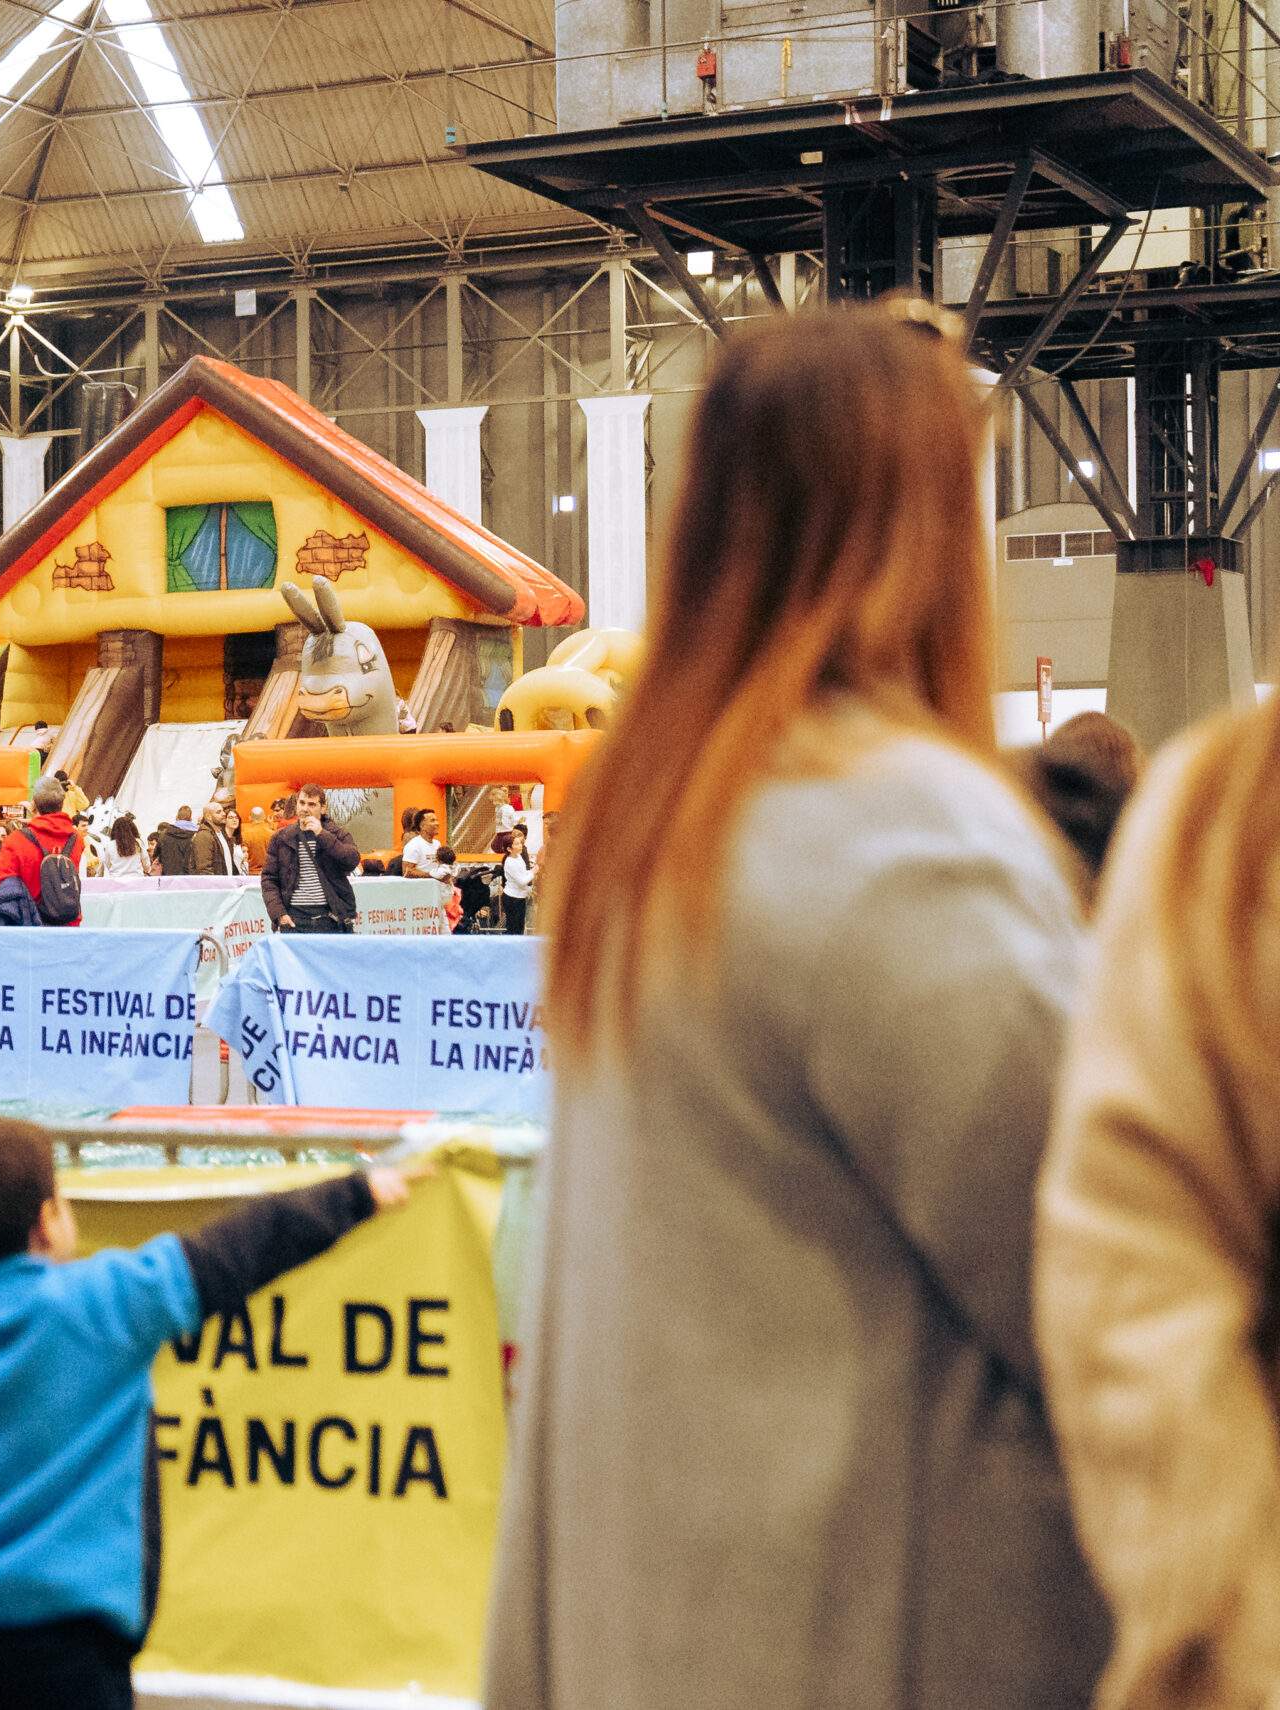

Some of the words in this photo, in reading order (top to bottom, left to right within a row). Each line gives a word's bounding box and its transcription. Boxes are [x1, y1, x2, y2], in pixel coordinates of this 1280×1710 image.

[41, 988, 155, 1019] FESTIVAL
[165, 993, 196, 1021] DE
[366, 995, 402, 1023] DE
[41, 1026, 72, 1055] LA
[81, 1023, 194, 1060] INFÀNCIA
[430, 1039, 464, 1070] LA
[343, 1298, 450, 1377] DE
